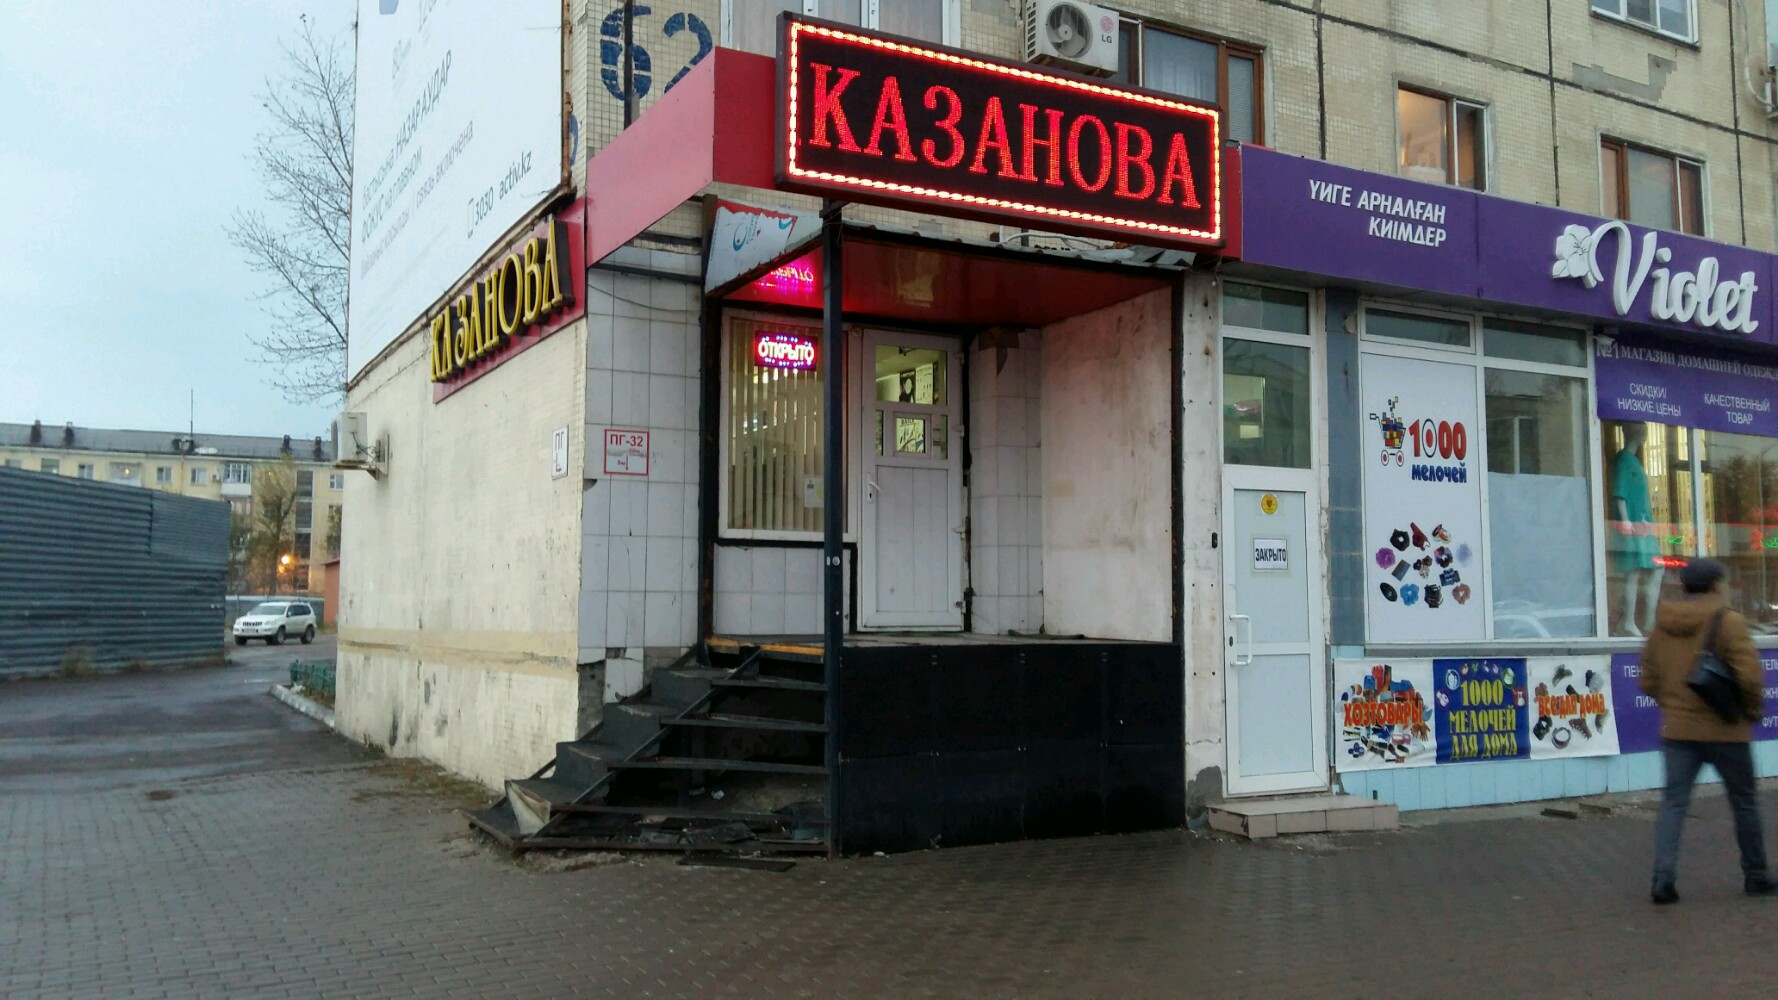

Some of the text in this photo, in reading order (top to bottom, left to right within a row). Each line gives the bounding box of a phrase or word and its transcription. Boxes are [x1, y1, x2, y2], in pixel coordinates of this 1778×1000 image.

[600, 5, 713, 101] 62
[1101, 34, 1112, 43] LG
[396, 98, 421, 160] НАЗАР
[421, 49, 452, 121] АУДАР
[809, 61, 1201, 209] КАЗАНОВА
[435, 120, 474, 184] включена
[475, 150, 532, 226] 3030 activ.kz
[1588, 220, 1759, 334] Violet
[430, 217, 565, 383] КАЗАНОВА
[757, 339, 815, 363] ОТКРЫТО
[1621, 345, 1676, 365] МАГАЗИН
[1678, 354, 1741, 376] ДОМАШНЕЙ
[1742, 366, 1778, 381] ОДЕЖД
[1617, 397, 1682, 417] НИЗКИЕ ЦЕНЫ
[1704, 392, 1771, 413] КАЧЕСТВЕННЫЙ
[1726, 411, 1753, 425] ТОВАР
[610, 434, 644, 447] ПГ-32
[1408, 418, 1467, 461] 1000
[1255, 547, 1287, 562] ЗАКРЫТО
[1460, 679, 1504, 707] 1000
[1343, 700, 1424, 728] ХОЗТОВАРЫ
[1449, 705, 1517, 734] МЕЛОЧЕЙ
[1451, 732, 1518, 761] ДЛЯ ДОМА
